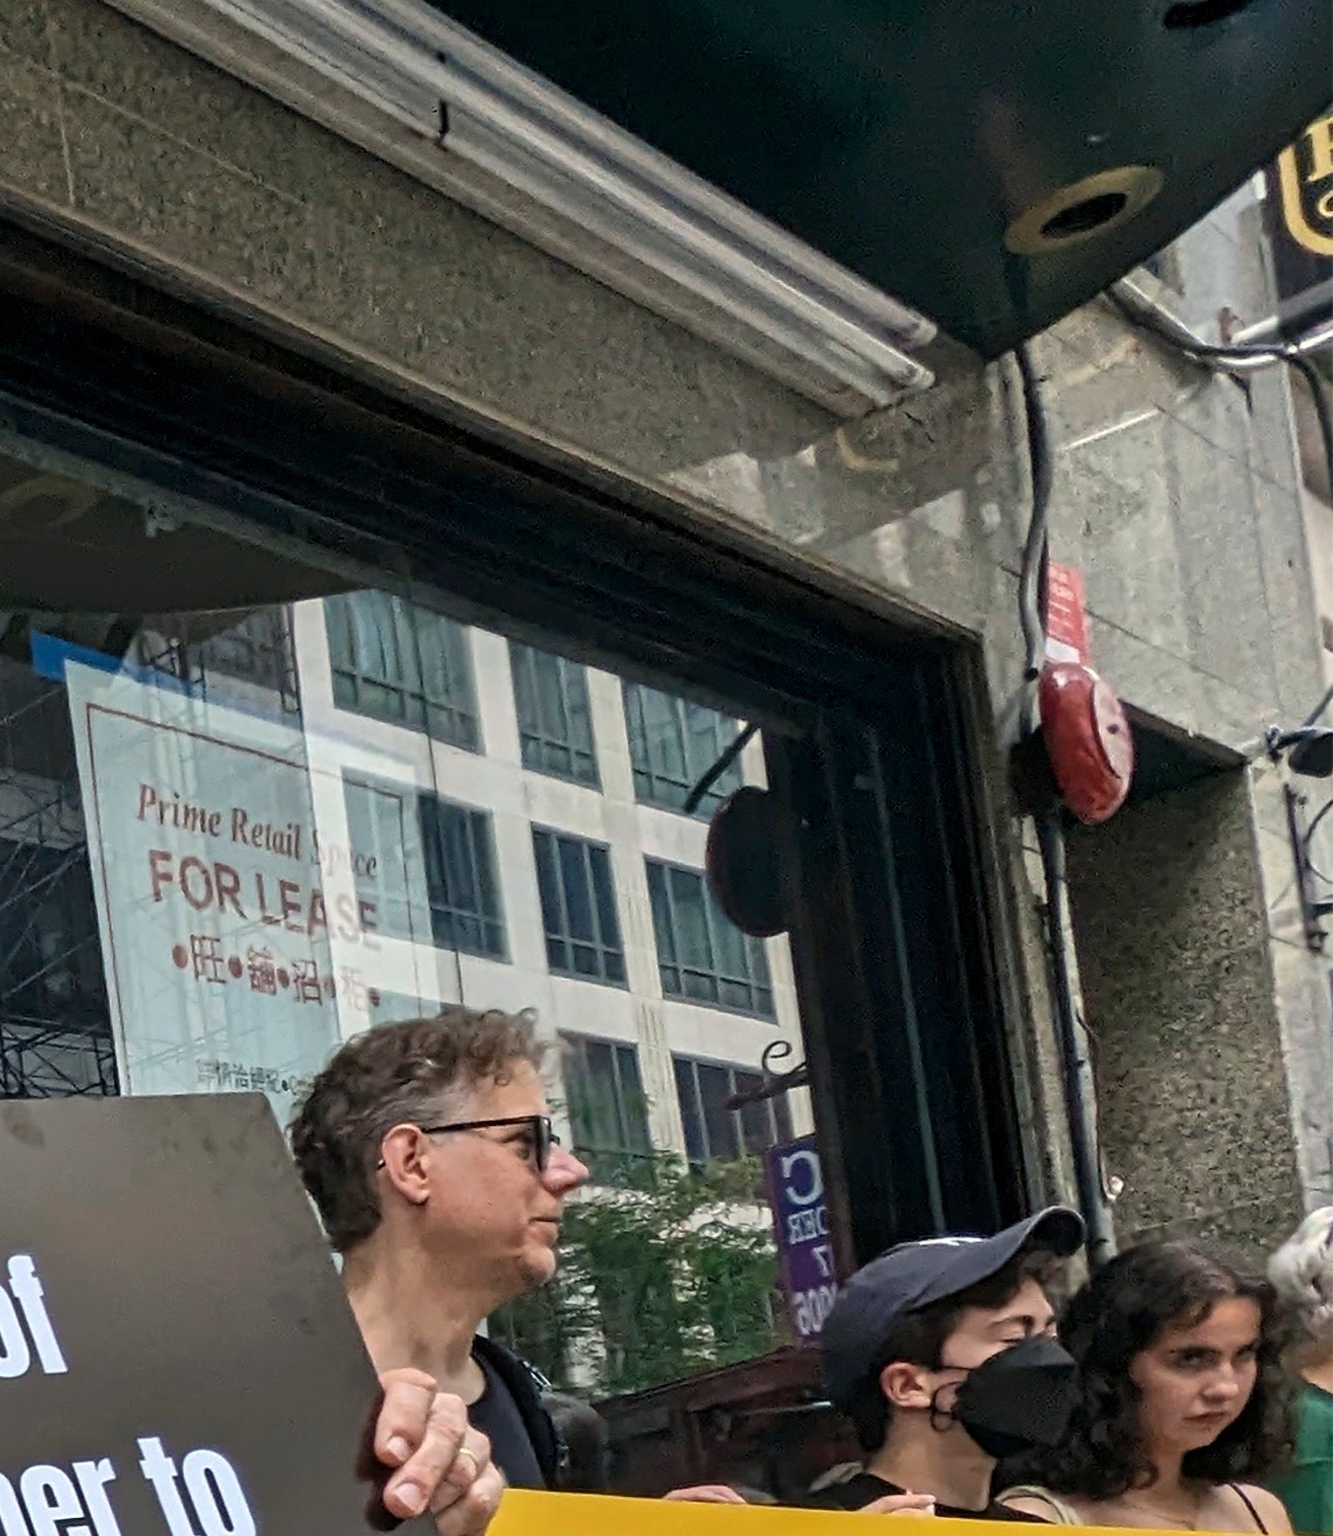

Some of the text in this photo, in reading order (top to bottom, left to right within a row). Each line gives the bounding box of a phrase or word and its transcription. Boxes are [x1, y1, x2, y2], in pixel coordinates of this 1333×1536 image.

[137, 783, 378, 880] Prime Retail Spce
[148, 848, 382, 950] FOR LEASE
